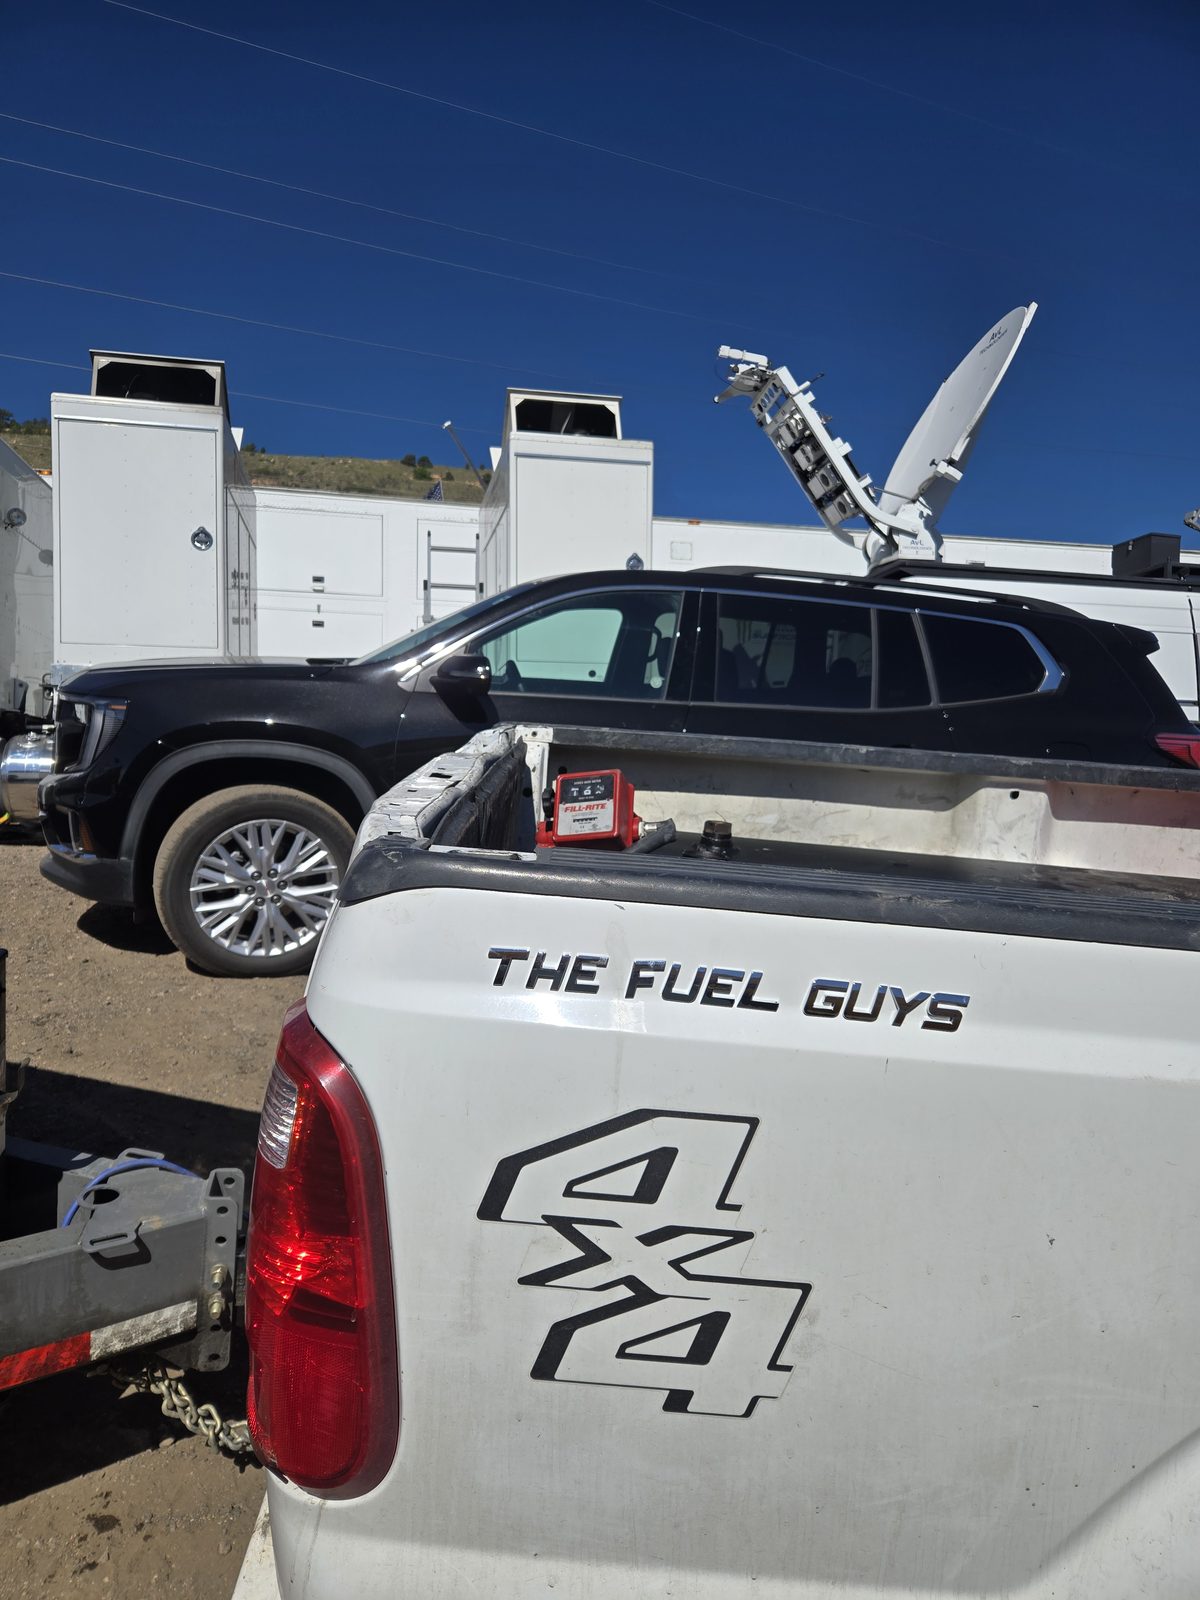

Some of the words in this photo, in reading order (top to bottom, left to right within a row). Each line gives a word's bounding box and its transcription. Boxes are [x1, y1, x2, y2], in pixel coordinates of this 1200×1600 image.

[564, 802, 608, 813] FILL-RITE
[487, 947, 609, 994] THE
[625, 959, 780, 1012] FUEL
[802, 977, 970, 1032] GUYS
